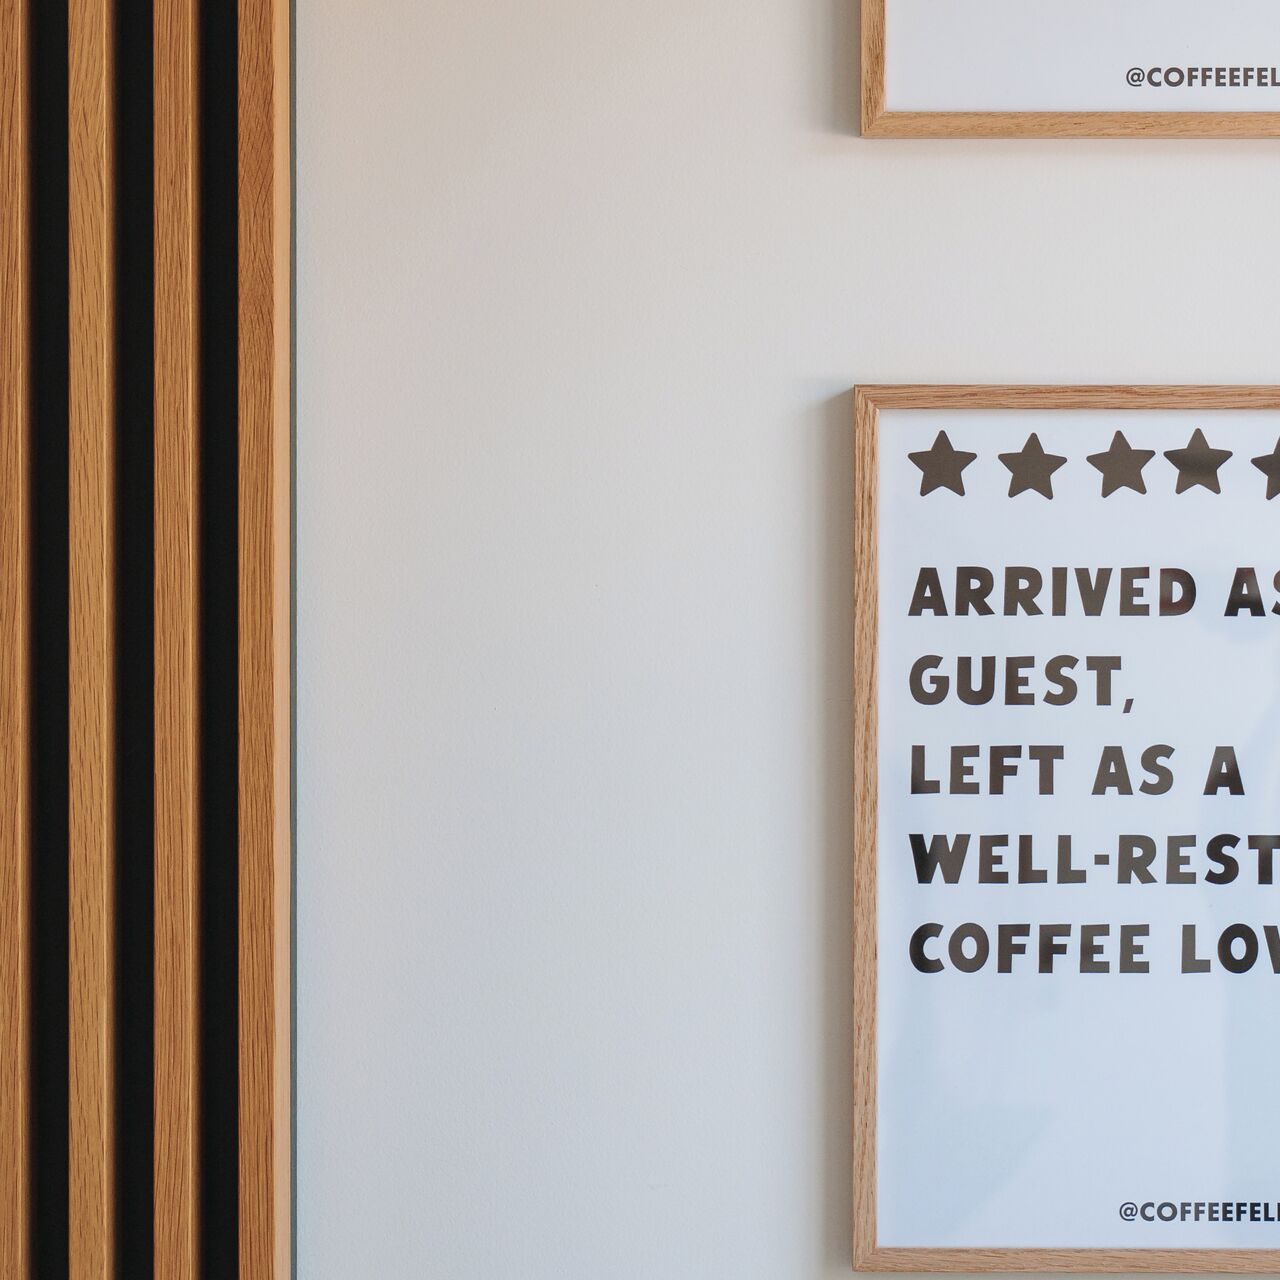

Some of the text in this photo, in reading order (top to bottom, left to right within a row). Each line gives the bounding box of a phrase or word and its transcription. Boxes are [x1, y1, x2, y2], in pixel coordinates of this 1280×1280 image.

[907, 565, 1197, 617] ARRIVED
[908, 654, 1134, 714] GUEST,
[909, 744, 1246, 796] LEFT AS A
[908, 922, 1150, 974] COFFEE
